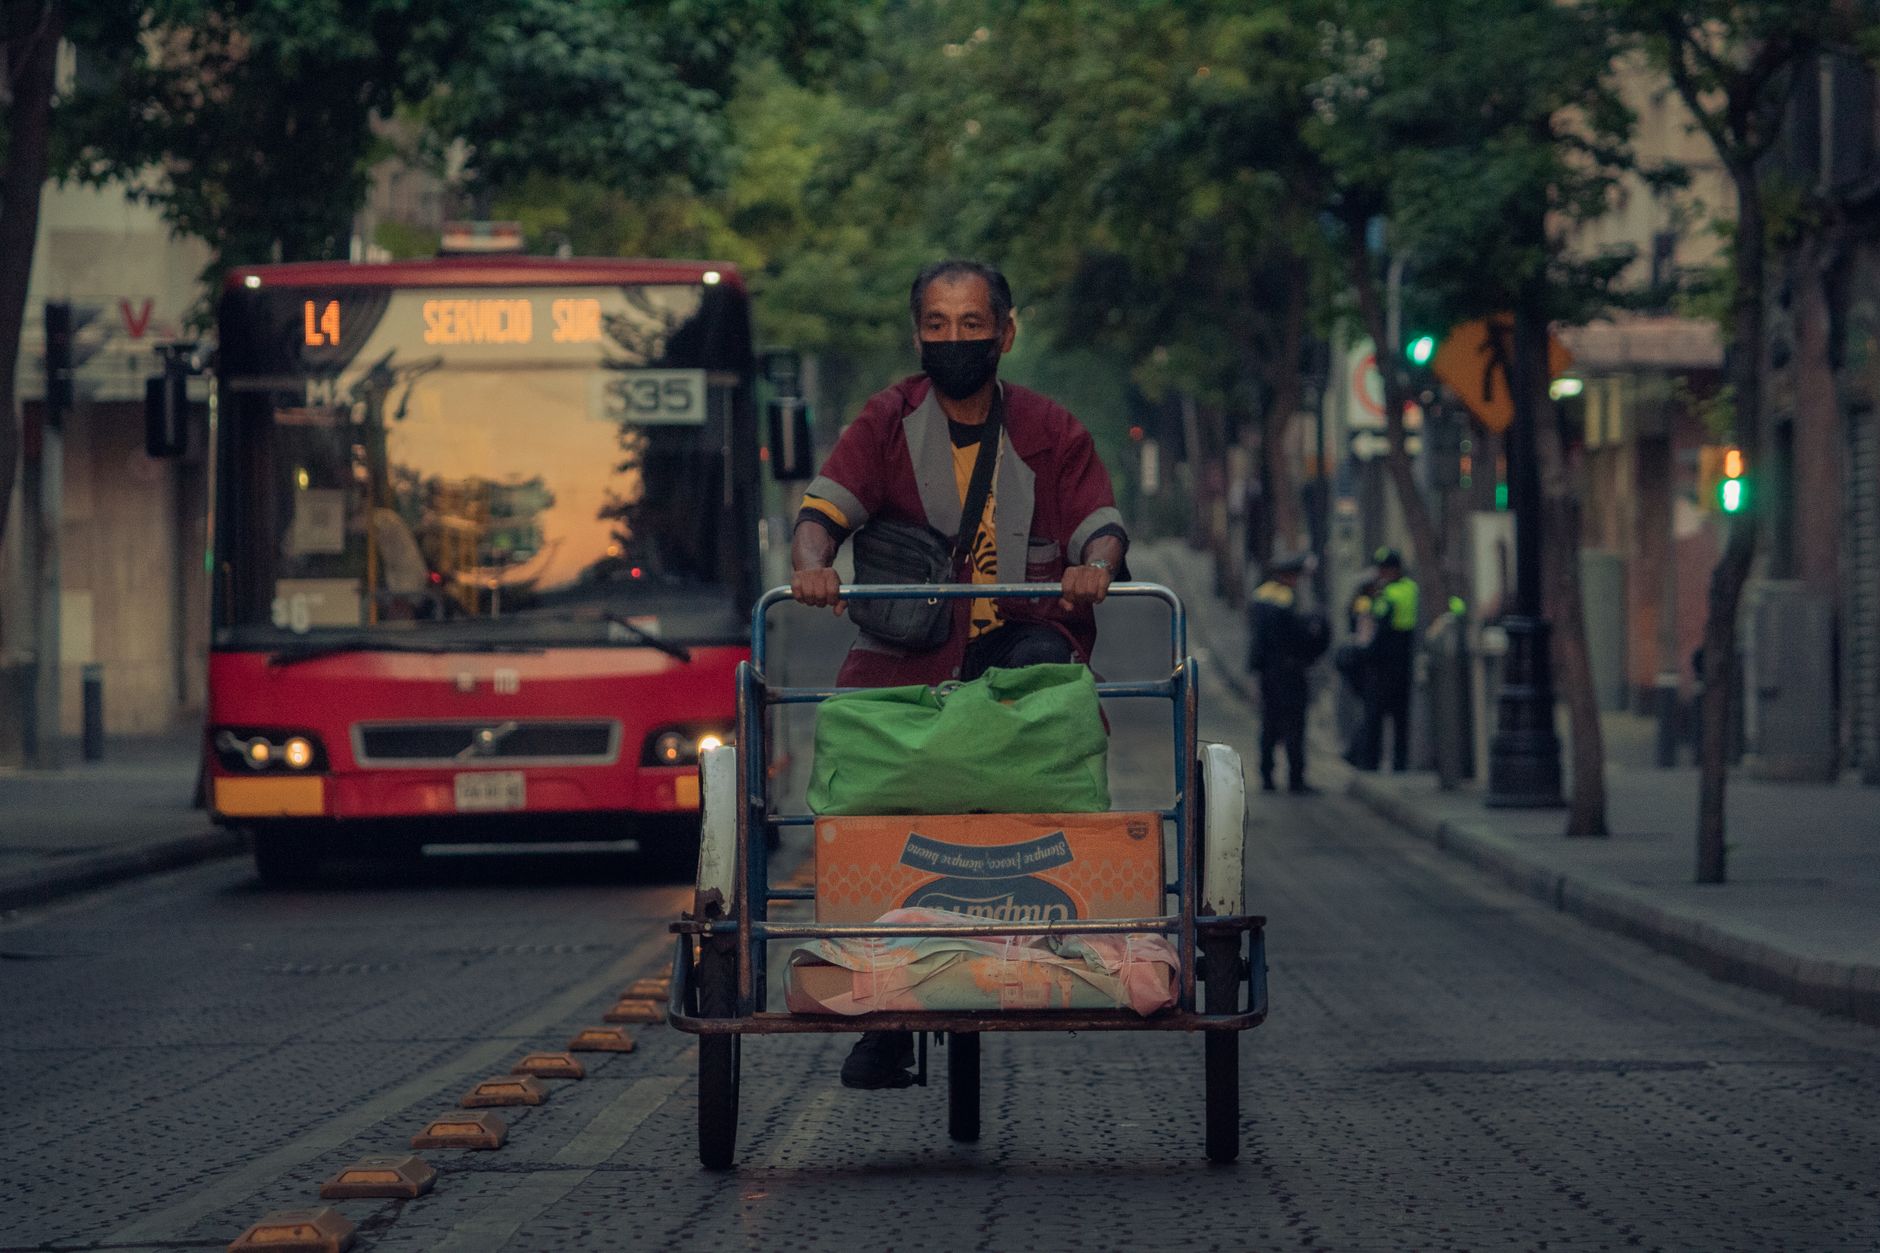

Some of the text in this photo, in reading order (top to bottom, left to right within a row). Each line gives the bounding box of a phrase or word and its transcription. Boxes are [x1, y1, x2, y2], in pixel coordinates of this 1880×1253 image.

[304, 300, 340, 346] L4
[422, 299, 601, 345] SERVICIO SUR
[907, 844, 938, 865] bueno
[1024, 841, 1066, 864] Siempre
